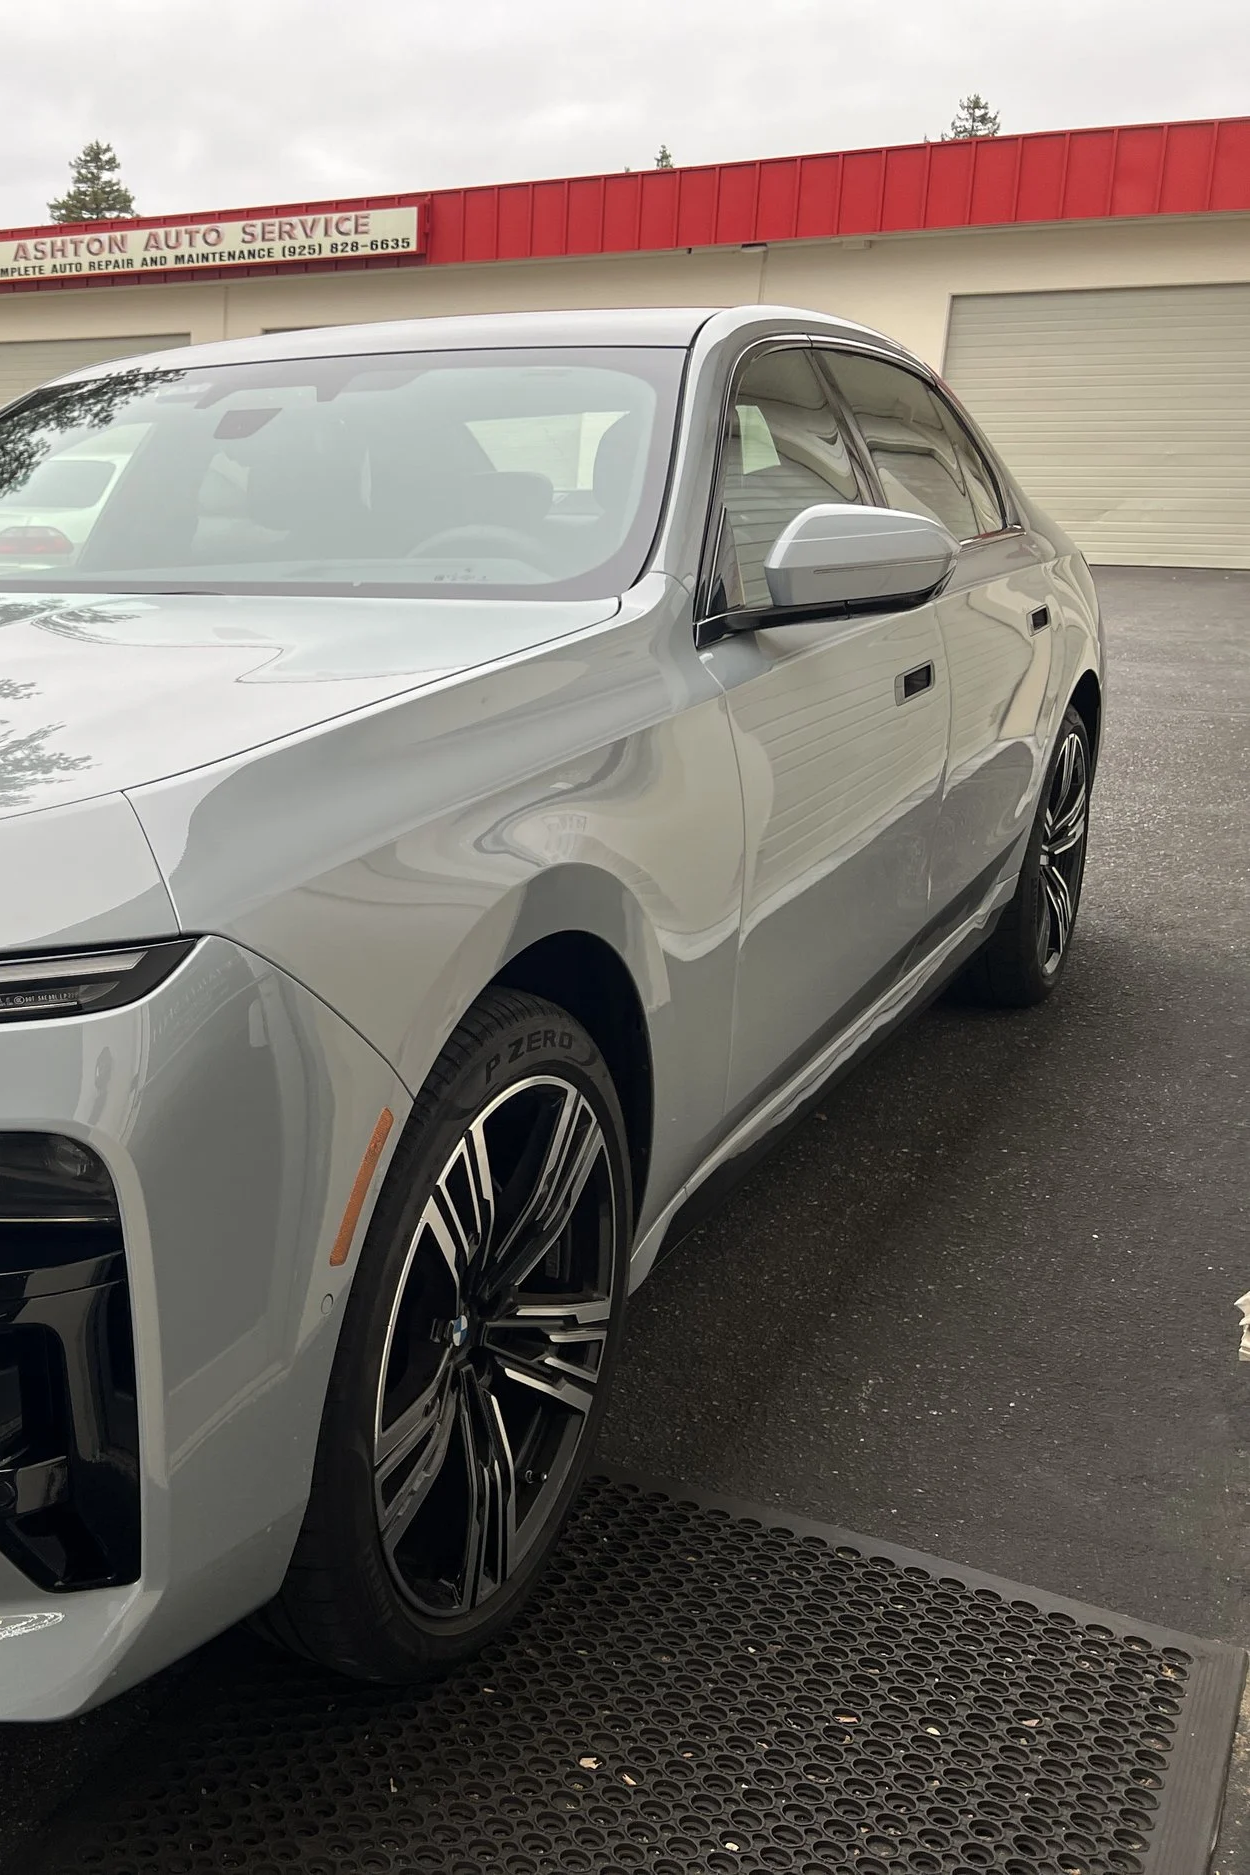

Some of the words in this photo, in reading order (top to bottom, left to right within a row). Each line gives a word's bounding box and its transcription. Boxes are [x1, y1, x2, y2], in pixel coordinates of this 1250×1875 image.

[13, 233, 128, 262] ASHTON
[144, 225, 224, 252] AUTO
[241, 213, 372, 244] SERVICE
[50, 262, 83, 275] AUTO
[88, 258, 135, 272] REPAIR
[140, 255, 168, 268] AND
[174, 247, 275, 265] MAINTENANCE
[281, 242, 323, 259] (925)
[329, 237, 411, 254] 828-6635
[485, 1053, 501, 1086] P
[508, 1028, 574, 1064] ZERO
